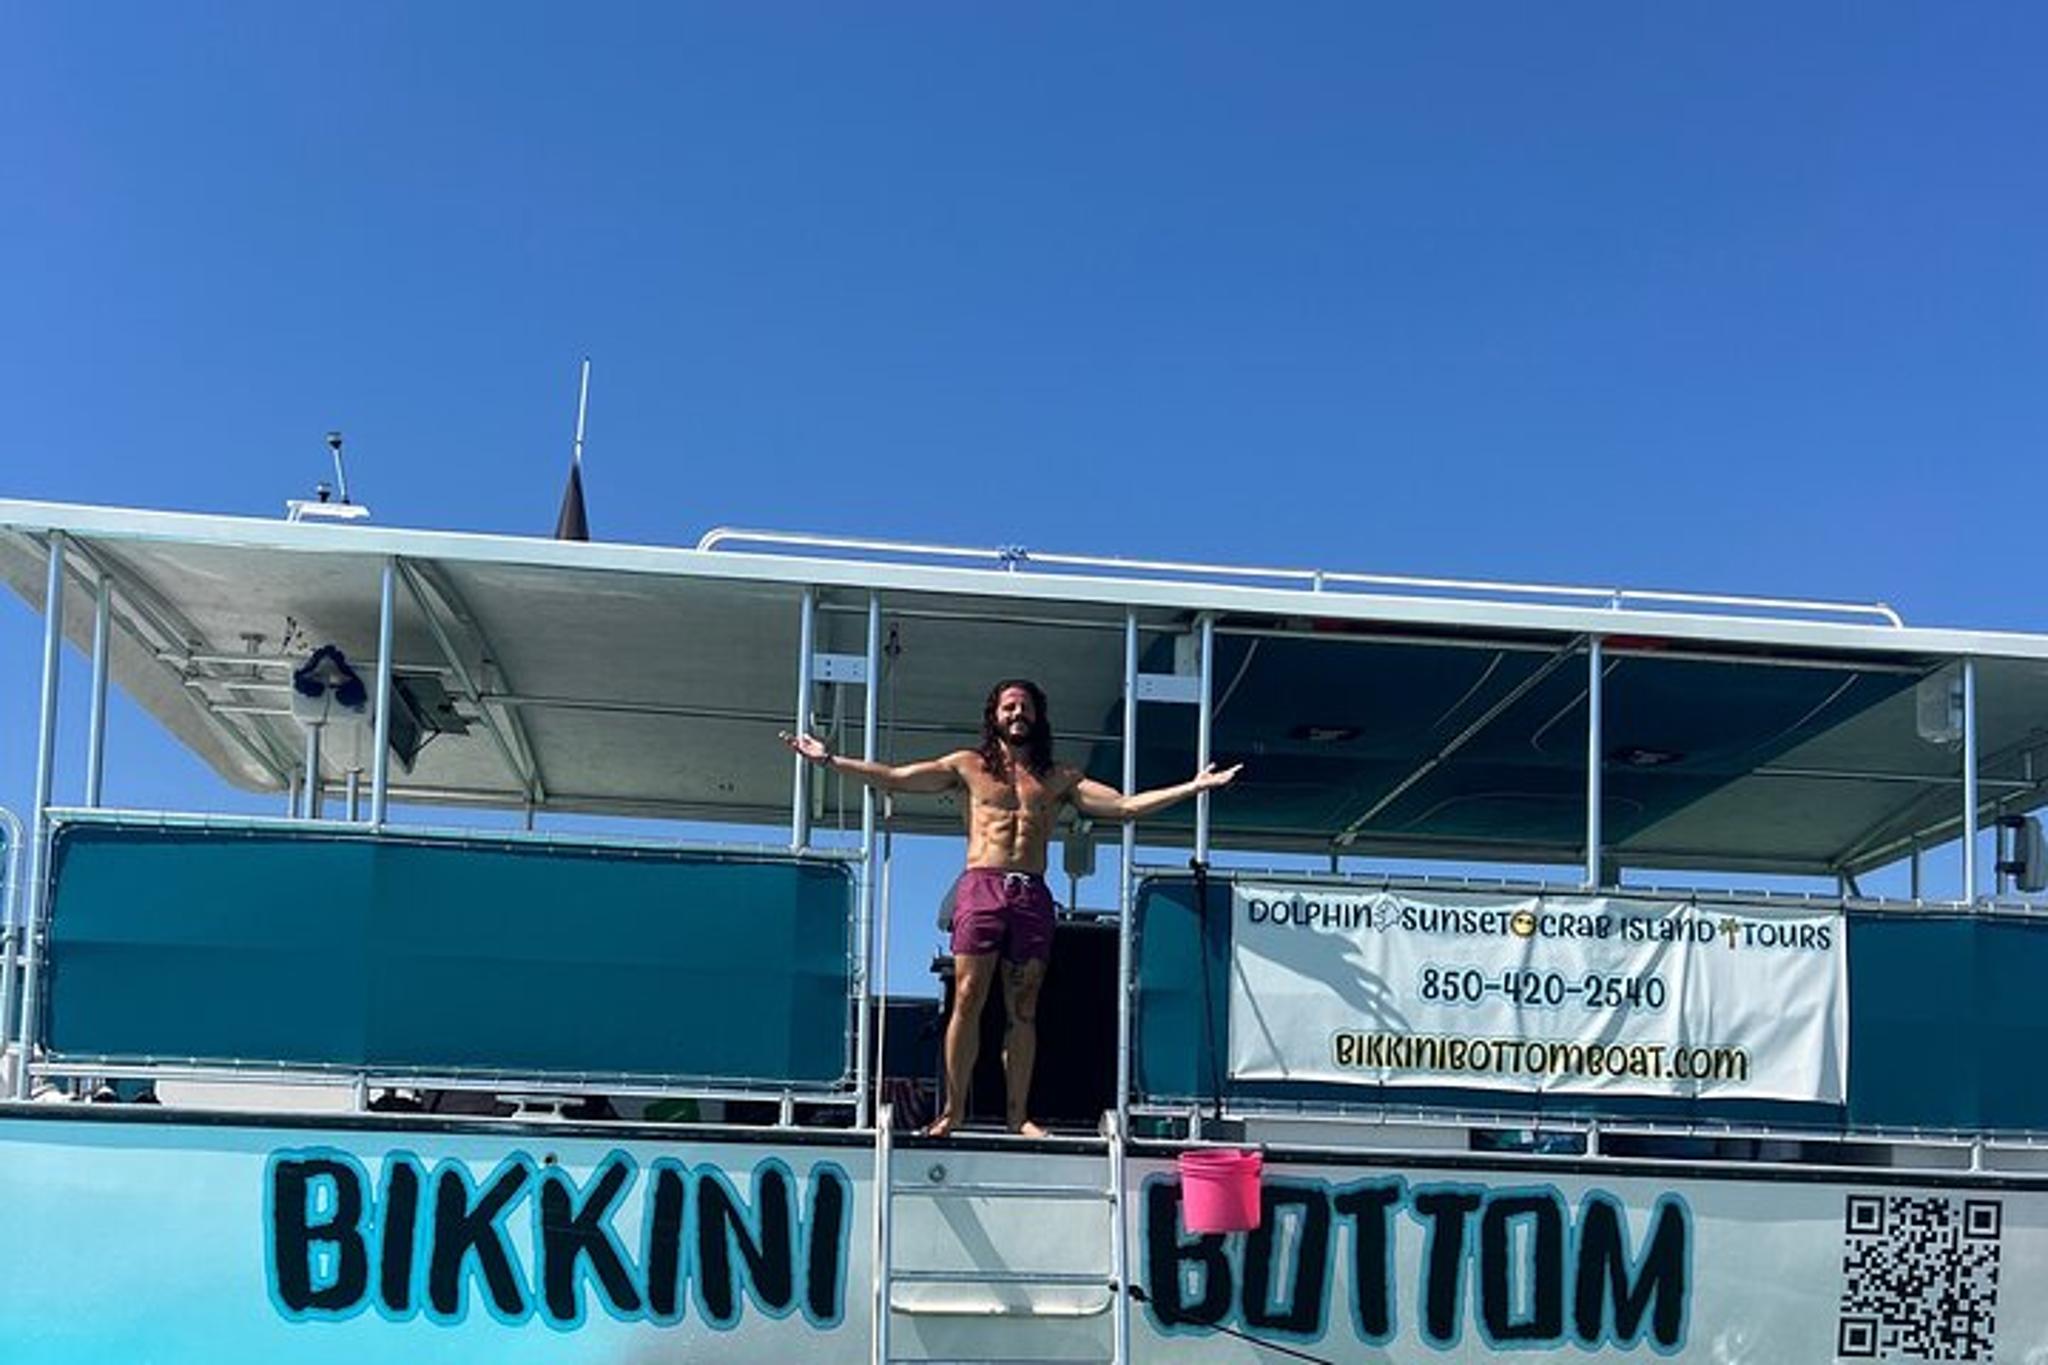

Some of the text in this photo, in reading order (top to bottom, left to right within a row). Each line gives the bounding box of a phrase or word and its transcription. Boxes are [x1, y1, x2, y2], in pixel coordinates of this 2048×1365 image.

[1422, 968, 1666, 1008] 850-420-2540
[273, 1158, 845, 1322] BIKKINI
[1146, 1181, 1687, 1353] BOTTOM
